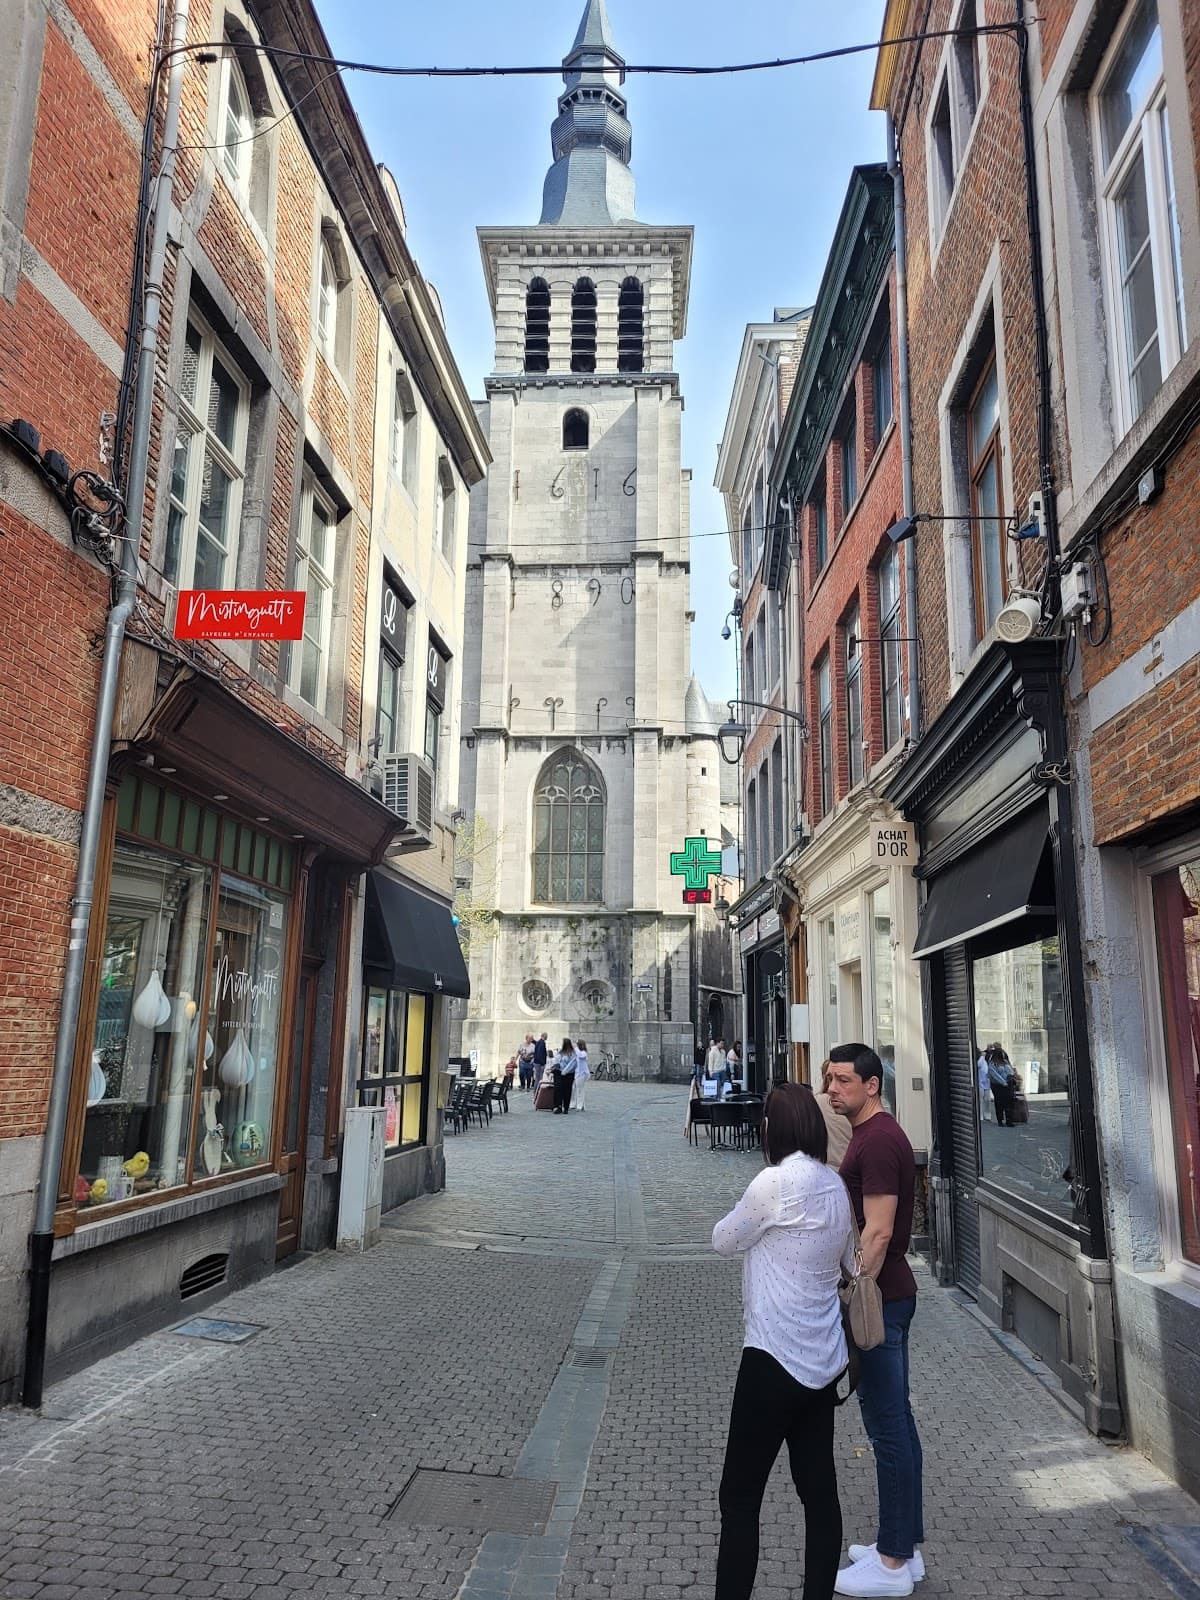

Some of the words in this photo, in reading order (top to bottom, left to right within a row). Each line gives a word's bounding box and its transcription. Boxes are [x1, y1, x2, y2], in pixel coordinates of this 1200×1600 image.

[187, 591, 294, 630] Mistinguette
[877, 830, 908, 840] ACHAT
[877, 842, 909, 857] D'OR
